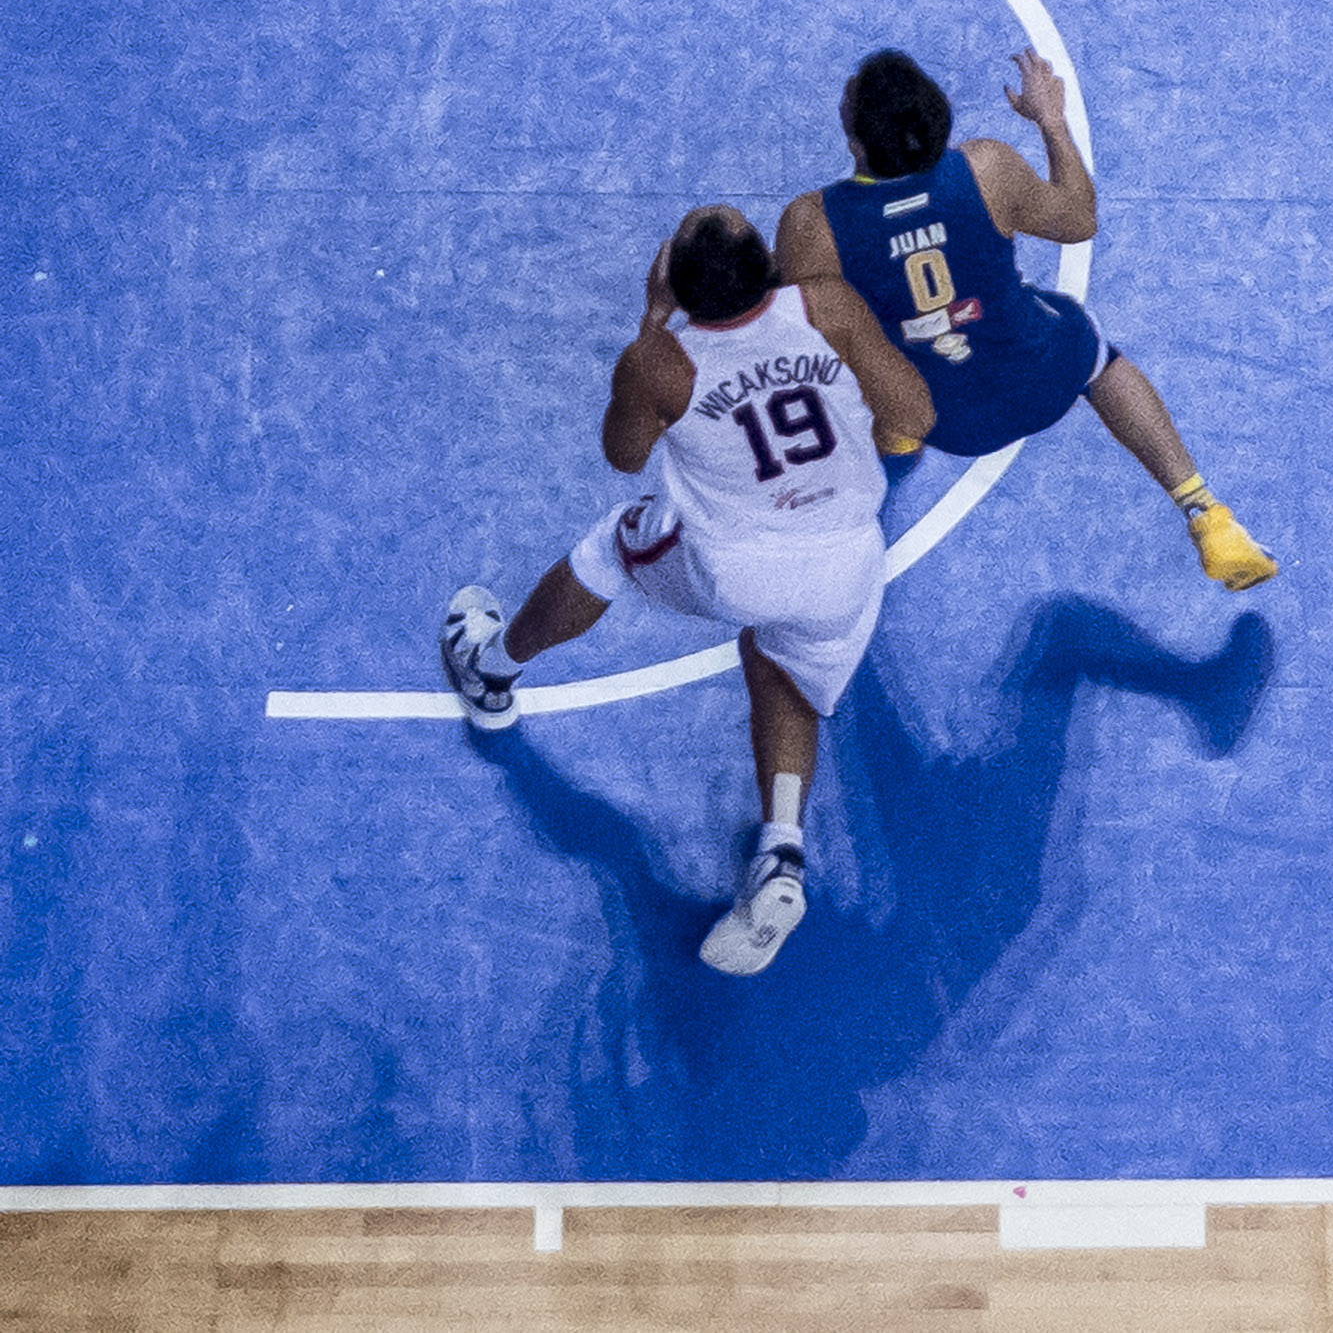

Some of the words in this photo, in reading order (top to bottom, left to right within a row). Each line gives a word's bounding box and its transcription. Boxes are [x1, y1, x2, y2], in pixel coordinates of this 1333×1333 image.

[889, 221, 948, 259] JUAN
[904, 248, 956, 314] 0
[694, 353, 842, 421] WICAKSONO
[732, 384, 837, 482] 19
